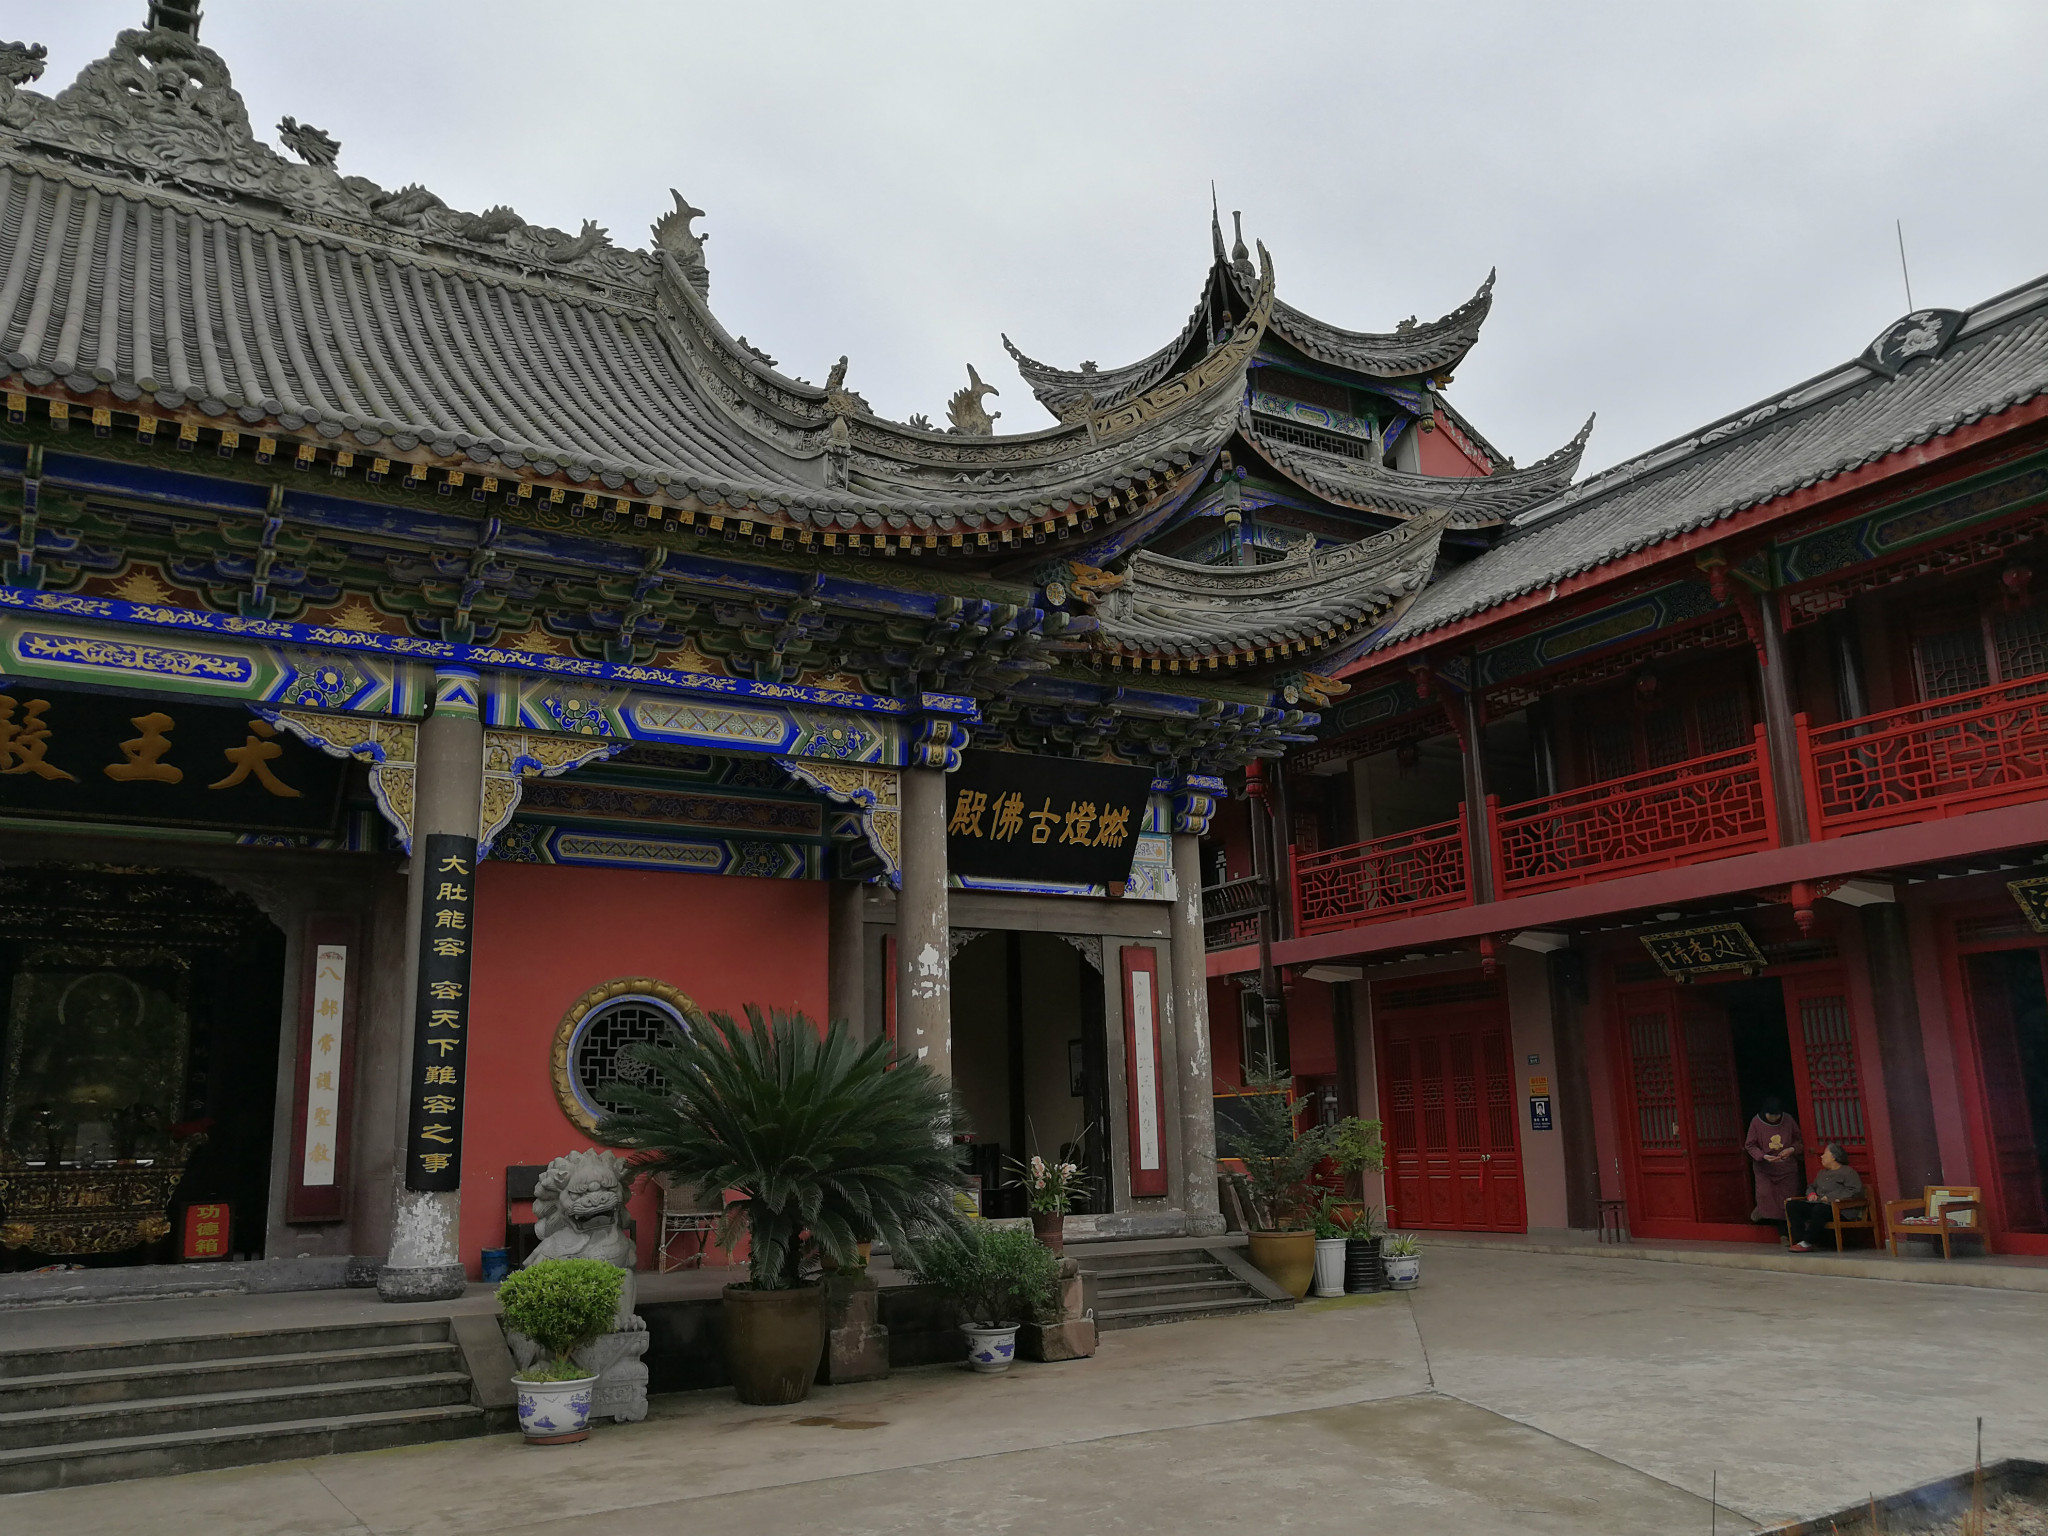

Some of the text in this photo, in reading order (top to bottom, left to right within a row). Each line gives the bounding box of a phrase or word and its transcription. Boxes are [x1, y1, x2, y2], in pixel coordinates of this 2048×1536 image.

[947, 788, 1131, 849] 燃燈古佛殿
[195, 1204, 220, 1253] 功德箱
